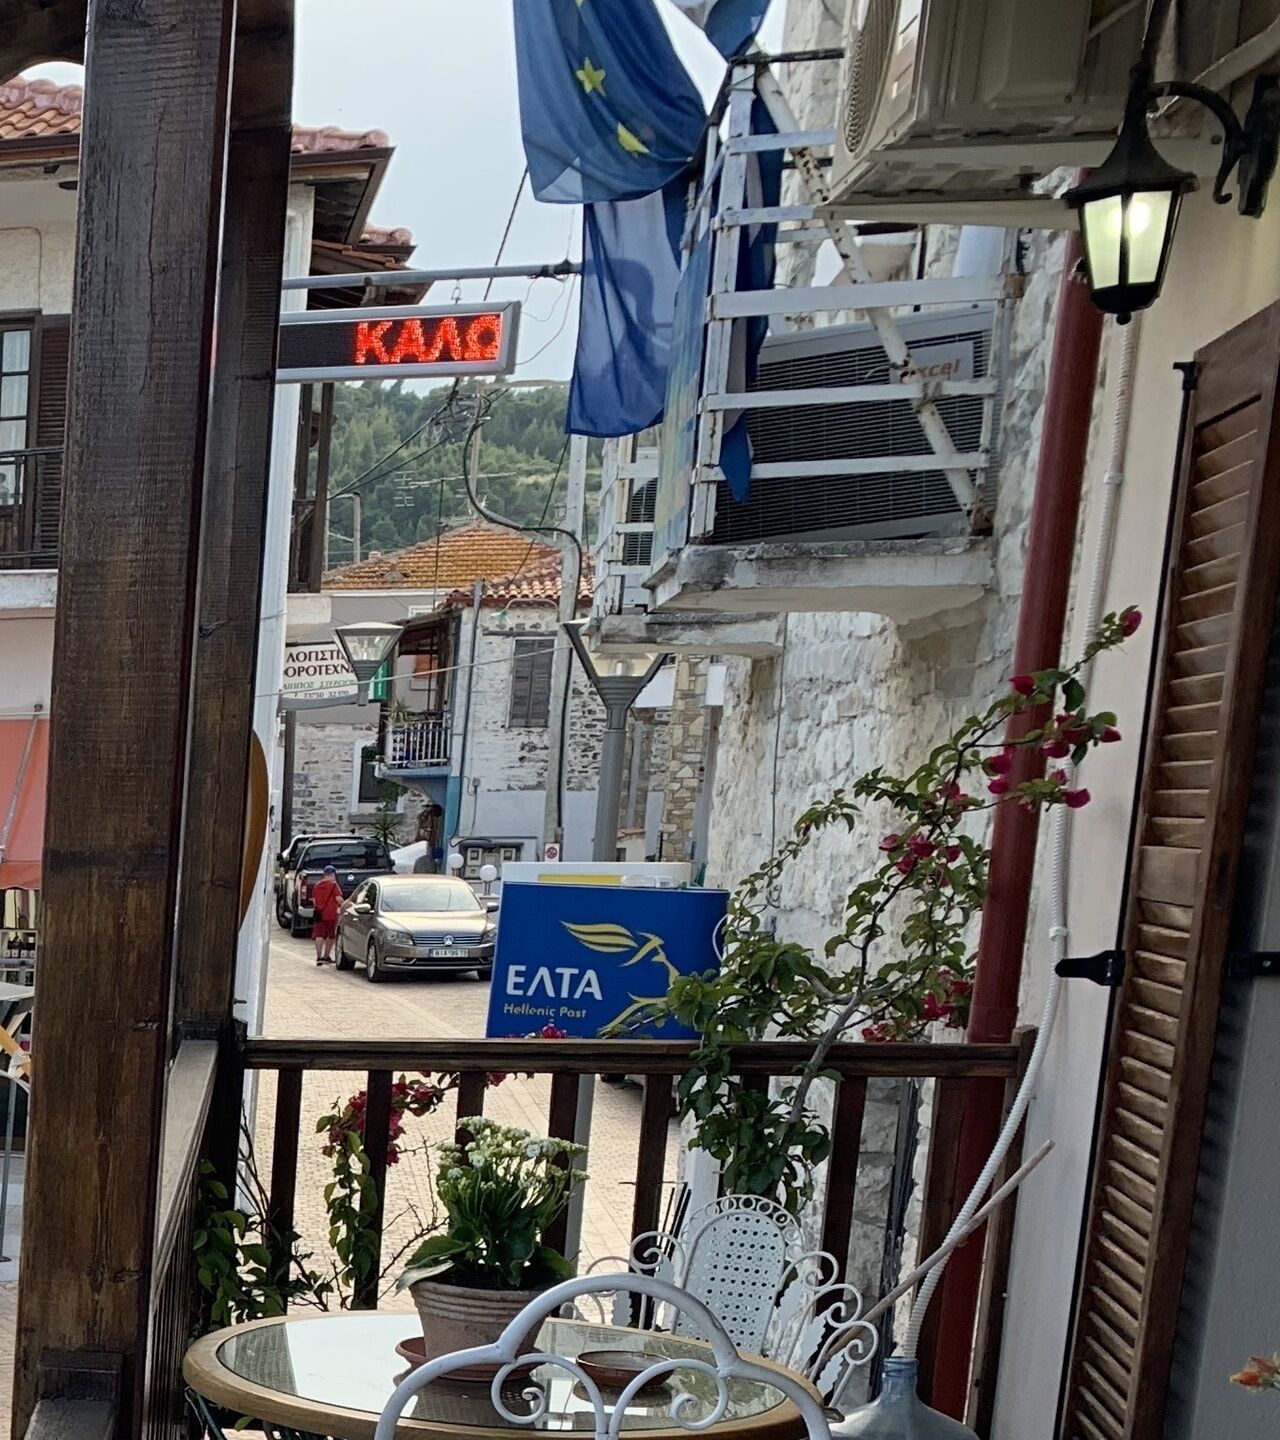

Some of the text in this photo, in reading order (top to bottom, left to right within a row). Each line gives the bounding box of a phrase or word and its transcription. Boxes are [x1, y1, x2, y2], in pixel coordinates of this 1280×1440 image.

[918, 360, 961, 378] xcel
[286, 649, 345, 663] ΛΟΓΙΣΤΙ
[283, 664, 355, 678] ΟΡΟΤΕΧΝ
[506, 964, 603, 1000] ΕΛΤΑ
[503, 1002, 587, 1018] Hellenic Post
